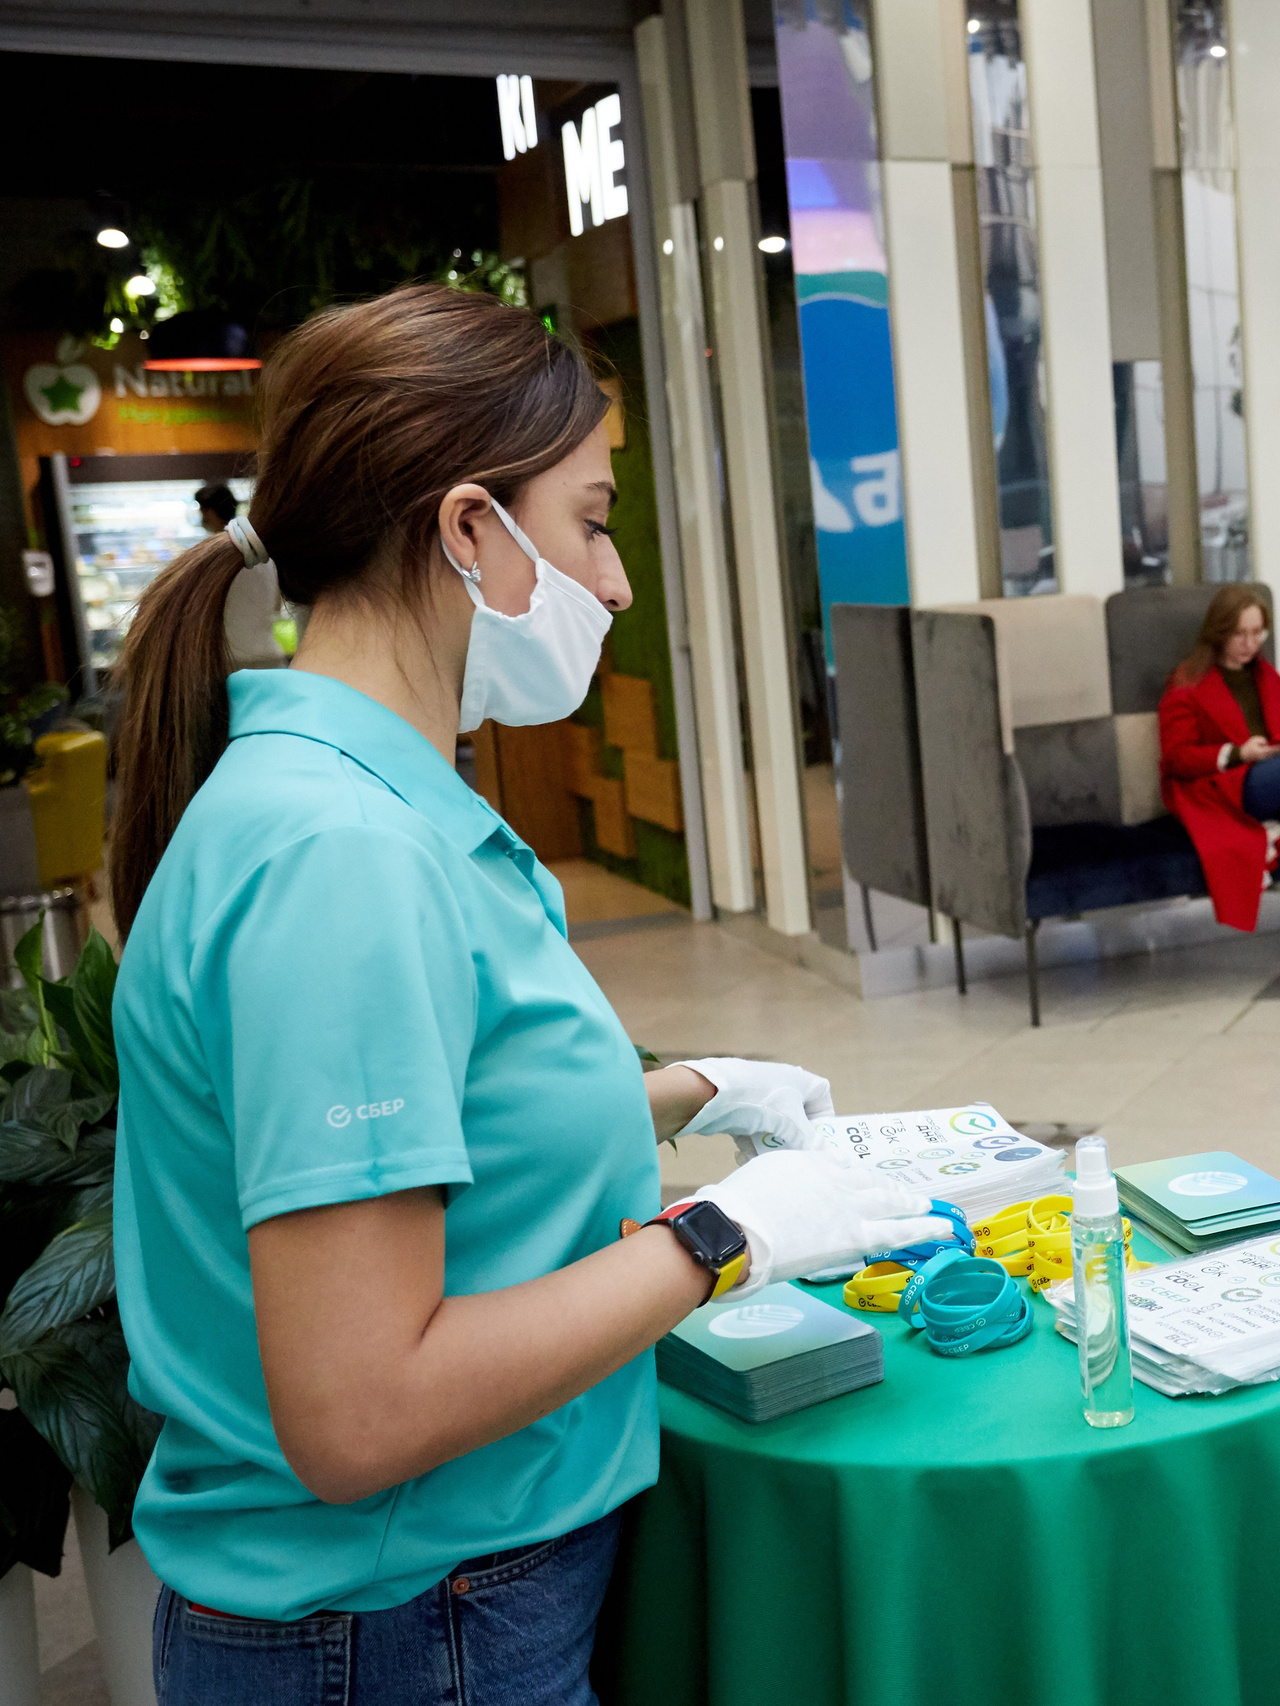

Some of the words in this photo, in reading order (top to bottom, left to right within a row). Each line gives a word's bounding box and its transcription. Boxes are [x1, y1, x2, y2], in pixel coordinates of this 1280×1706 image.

[356, 1098, 405, 1119] СБЕР
[846, 1127, 871, 1159] COOL
[1165, 1274, 1205, 1292] COOL
[1151, 1286, 1191, 1304] СБЕР
[948, 1343, 970, 1354] СБЕР
